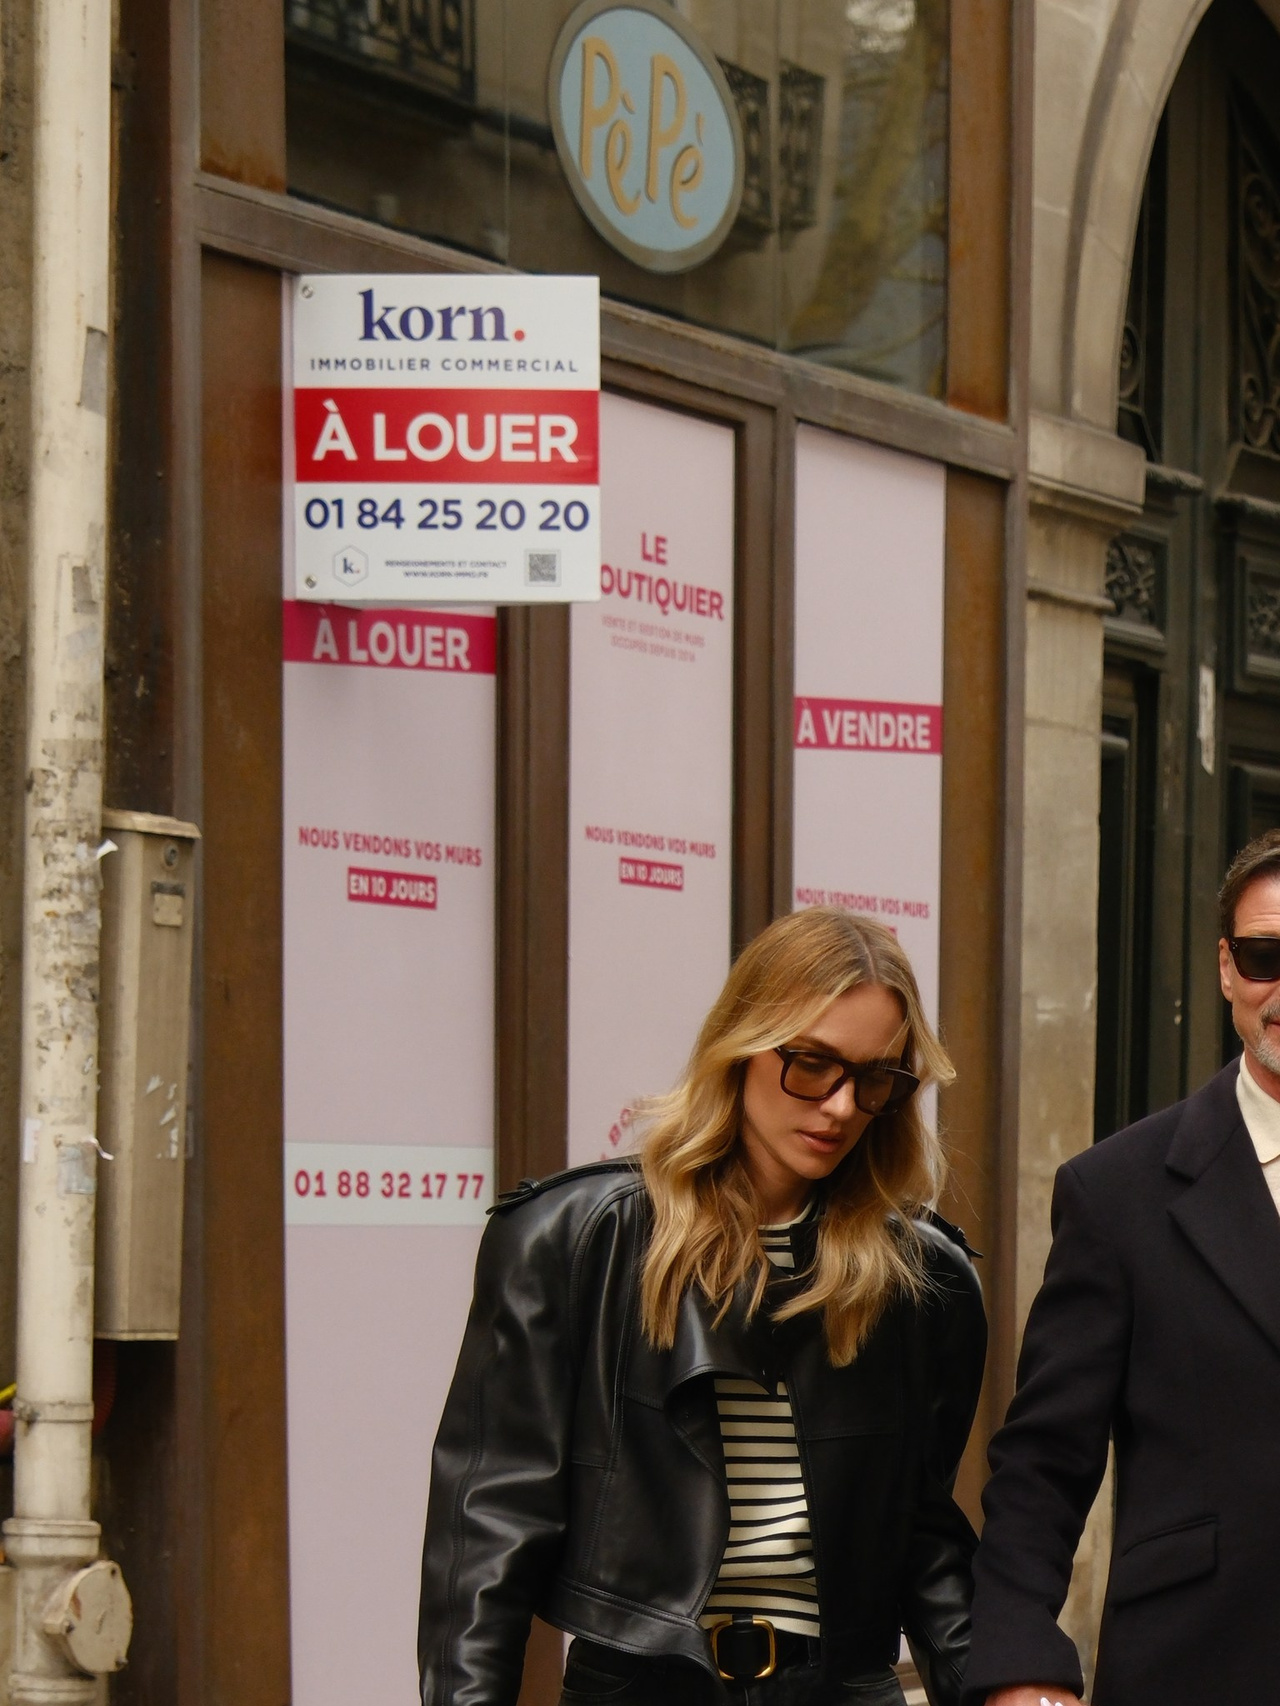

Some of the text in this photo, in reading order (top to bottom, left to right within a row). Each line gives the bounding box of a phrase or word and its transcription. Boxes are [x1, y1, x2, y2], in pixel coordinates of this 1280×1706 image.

[357, 288, 525, 342] korn.
[310, 358, 579, 373] IMMOBILIER COMMERCIAL
[312, 398, 579, 463] À LOUER
[305, 498, 589, 532] 01 84 25 20 20
[641, 532, 668, 566] LE
[600, 564, 724, 621] OUTIQUIER
[348, 620, 471, 670] LOUER
[822, 708, 932, 749] VENDRE
[299, 826, 482, 867] NOUS VENDONS VOS MURS
[585, 825, 716, 859] NOUS VENDONS VOS MURS
[350, 873, 436, 903] EN 10 JOURS
[621, 862, 682, 886] EN 10 JOURS
[796, 887, 930, 919] NOUS VENDONS VOS MURS
[295, 1170, 484, 1200] 01 88 32 17 77
